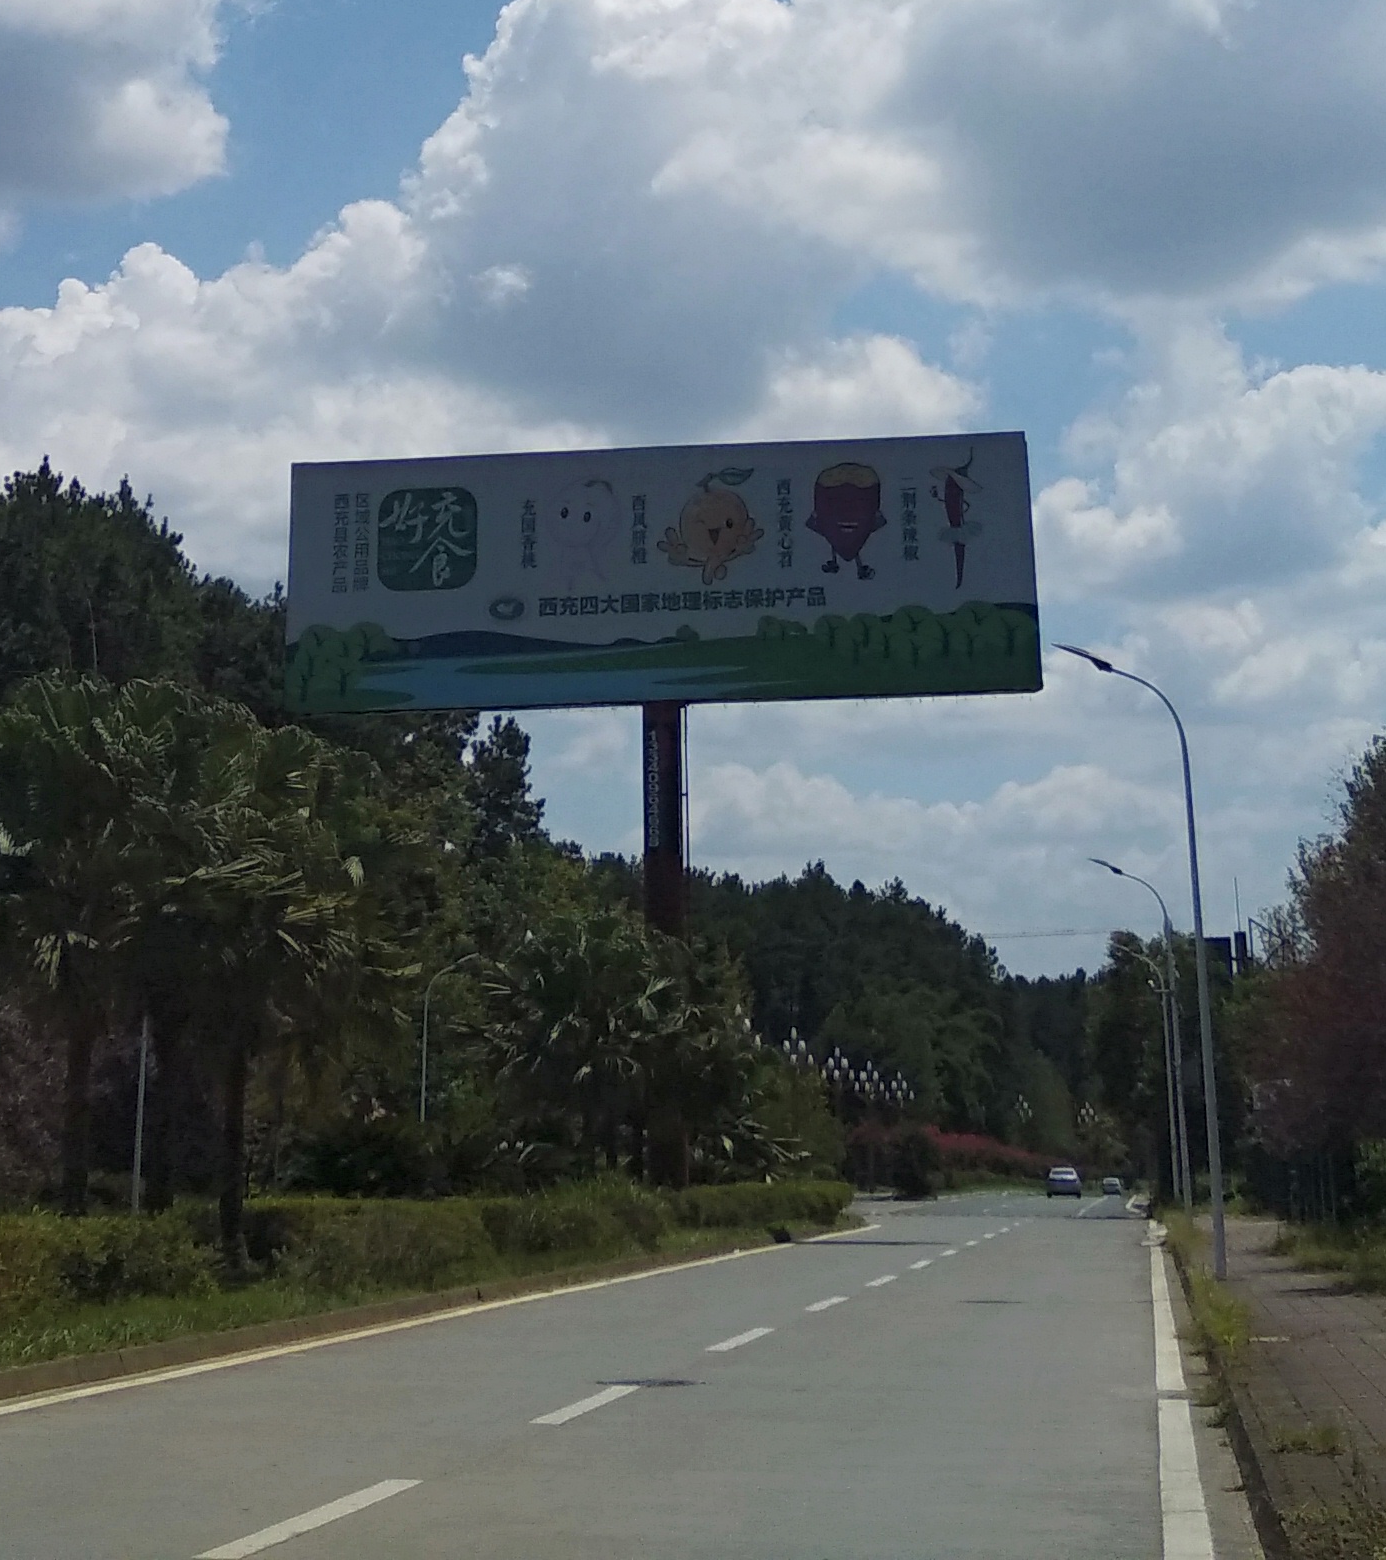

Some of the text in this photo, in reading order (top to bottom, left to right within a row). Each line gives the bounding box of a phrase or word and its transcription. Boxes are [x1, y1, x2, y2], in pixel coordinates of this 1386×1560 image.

[538, 587, 827, 617] 西充四大国家地理标志保护产品
